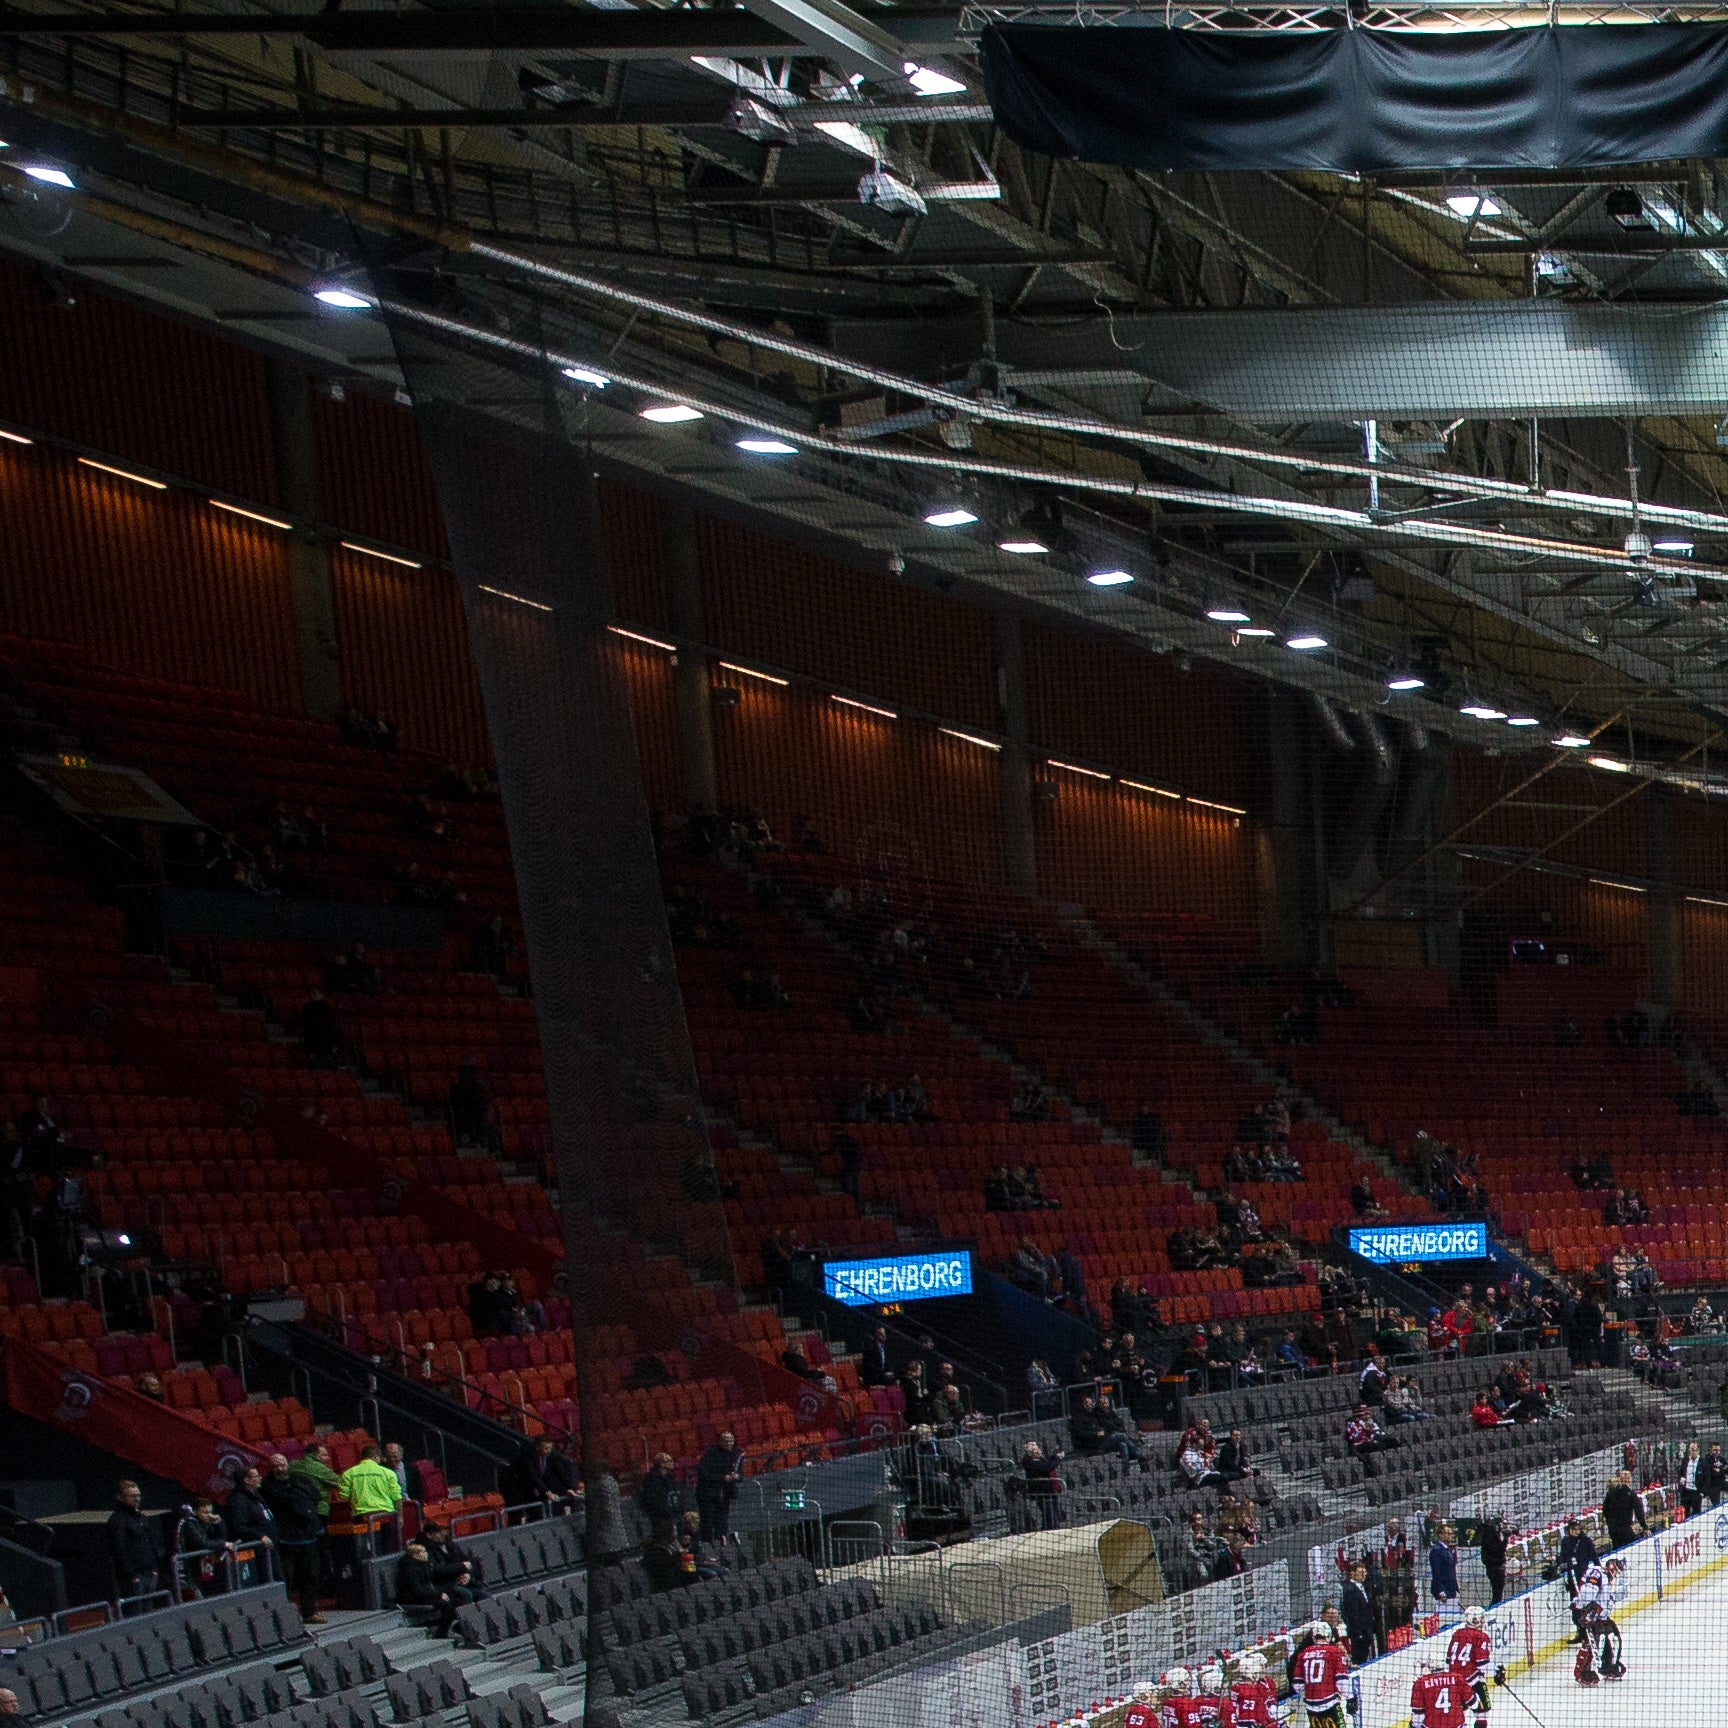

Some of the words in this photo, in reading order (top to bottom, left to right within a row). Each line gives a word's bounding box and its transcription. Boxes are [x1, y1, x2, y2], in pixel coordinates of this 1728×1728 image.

[1358, 1229, 1479, 1258] EHRENBORG
[834, 1260, 963, 1299] EHRENBORG
[1303, 1658, 1326, 1684] 10
[1434, 1687, 1452, 1714] 4
